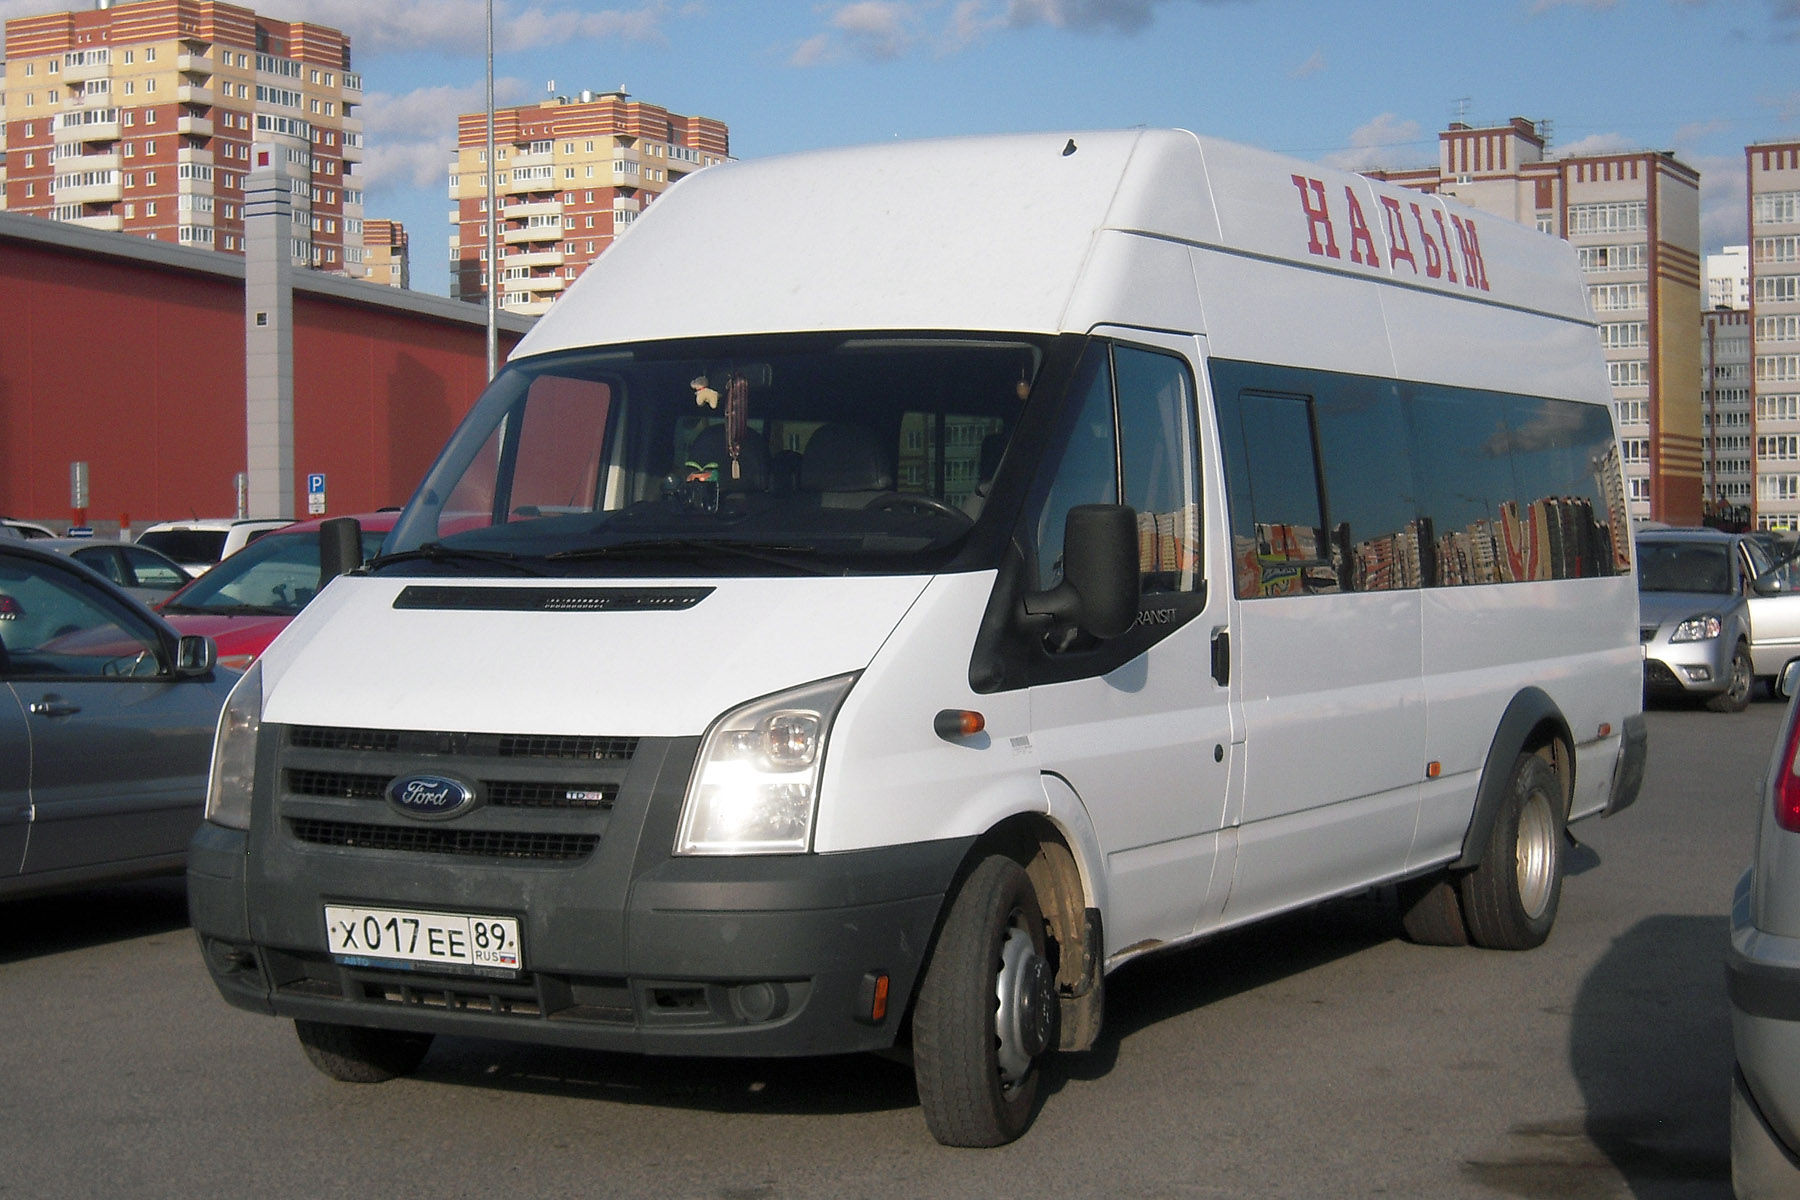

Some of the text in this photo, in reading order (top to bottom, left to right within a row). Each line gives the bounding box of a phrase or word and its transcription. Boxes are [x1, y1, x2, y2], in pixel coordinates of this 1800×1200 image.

[1291, 174, 1490, 291] НАДЫМ
[312, 476, 322, 492] P
[1130, 608, 1177, 627] RANSIT
[402, 780, 449, 806] Ford
[474, 921, 506, 951] 89
[475, 950, 499, 962] RUS
